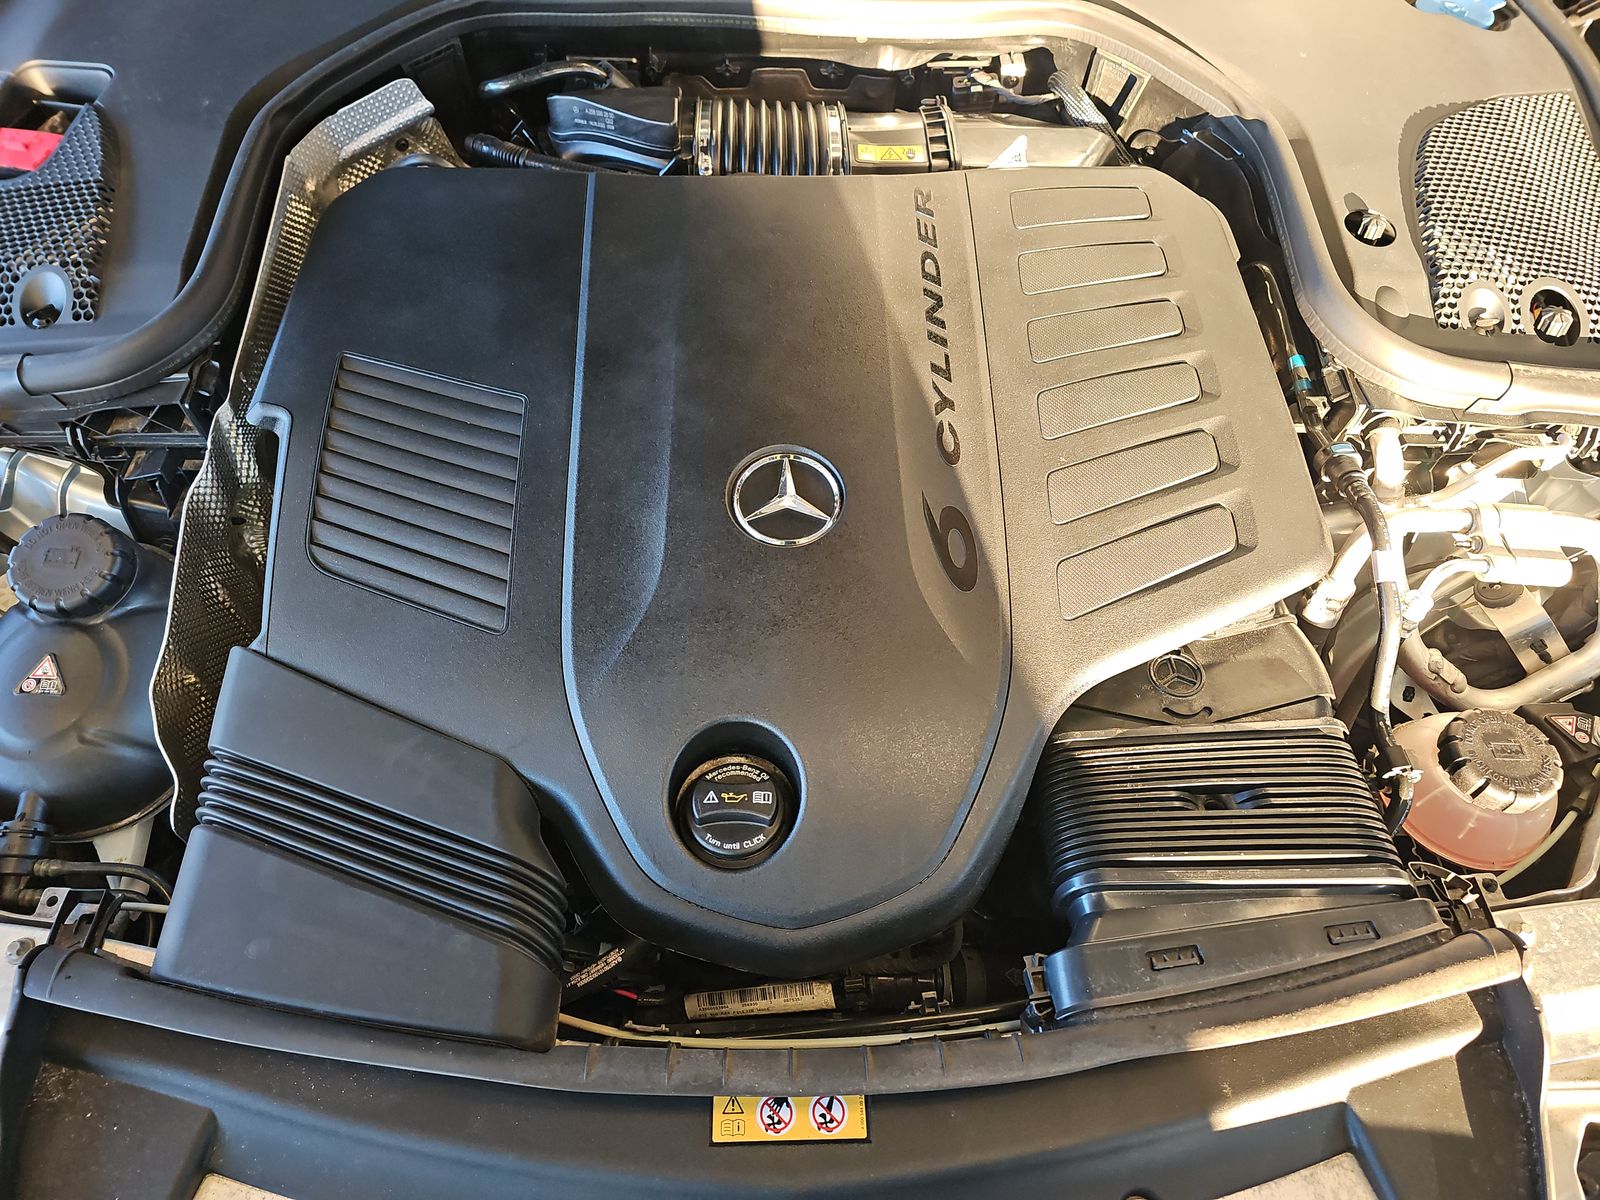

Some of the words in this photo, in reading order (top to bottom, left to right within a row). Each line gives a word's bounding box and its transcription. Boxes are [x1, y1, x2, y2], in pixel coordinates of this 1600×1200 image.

[913, 186, 961, 468] CYLINDER
[922, 489, 980, 592] 6
[705, 765, 760, 780] Mercedes-Benz
[714, 770, 762, 782] recommended
[705, 833, 721, 847] Turn
[723, 842, 740, 850] until
[743, 833, 767, 849] CLICK
